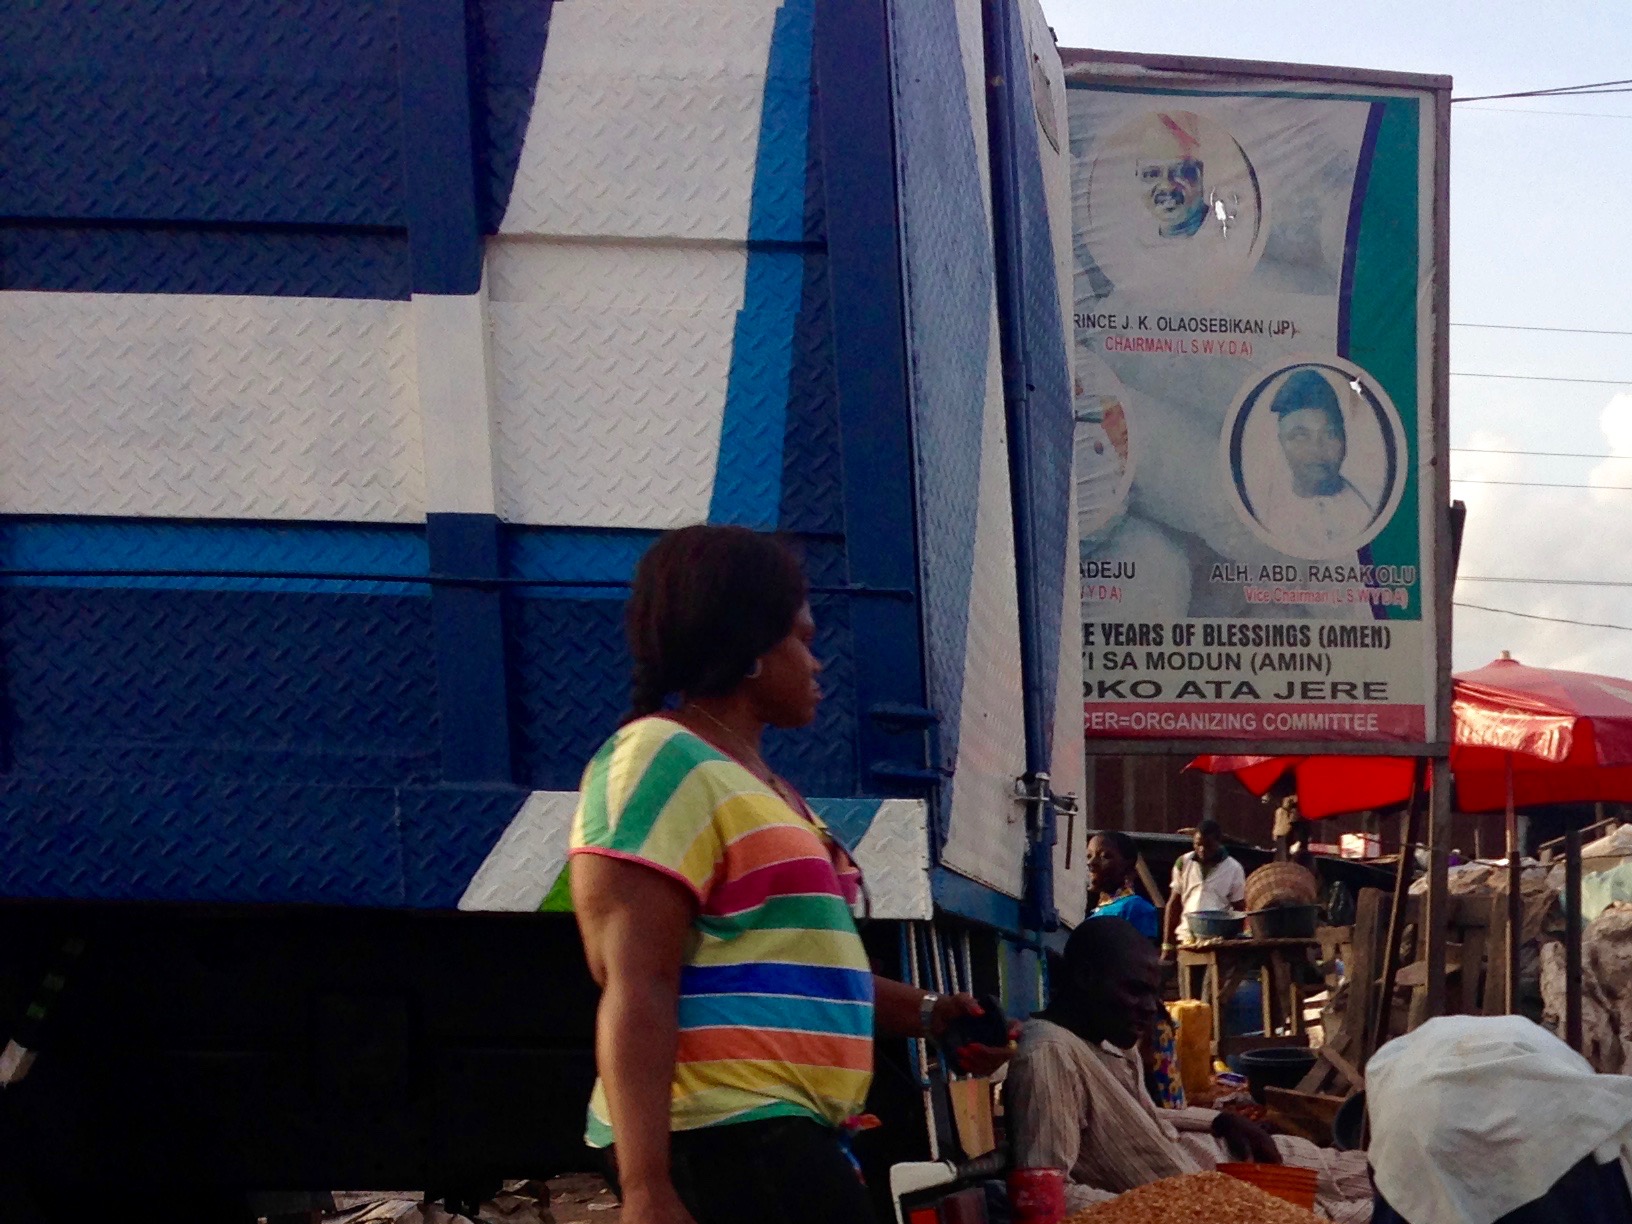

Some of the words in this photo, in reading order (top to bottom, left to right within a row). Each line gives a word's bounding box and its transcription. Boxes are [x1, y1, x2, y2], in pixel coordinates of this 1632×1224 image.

[1138, 315, 1152, 330] K.
[1157, 316, 1263, 334] OLAOSEBIKAN
[1105, 336, 1172, 352] CHAIRMAN
[1211, 564, 1252, 582] ALH.
[1258, 564, 1302, 582] ABD.
[1308, 565, 1373, 584] RASAK
[1378, 566, 1414, 585] OLU
[1244, 586, 1271, 603] Vice
[1274, 586, 1329, 604] Chairman
[1101, 623, 1164, 647] YEARS
[1172, 623, 1195, 646] OF
[1203, 624, 1310, 648] BLESSINGS
[1319, 625, 1391, 650] (AMEN)
[1103, 651, 1138, 670] SA
[1146, 652, 1241, 670] MODUN
[1250, 652, 1331, 676] (AMIN)
[1176, 680, 1261, 700] ATA
[1273, 681, 1388, 701] JERE
[1262, 713, 1379, 731] COMMITTEE
